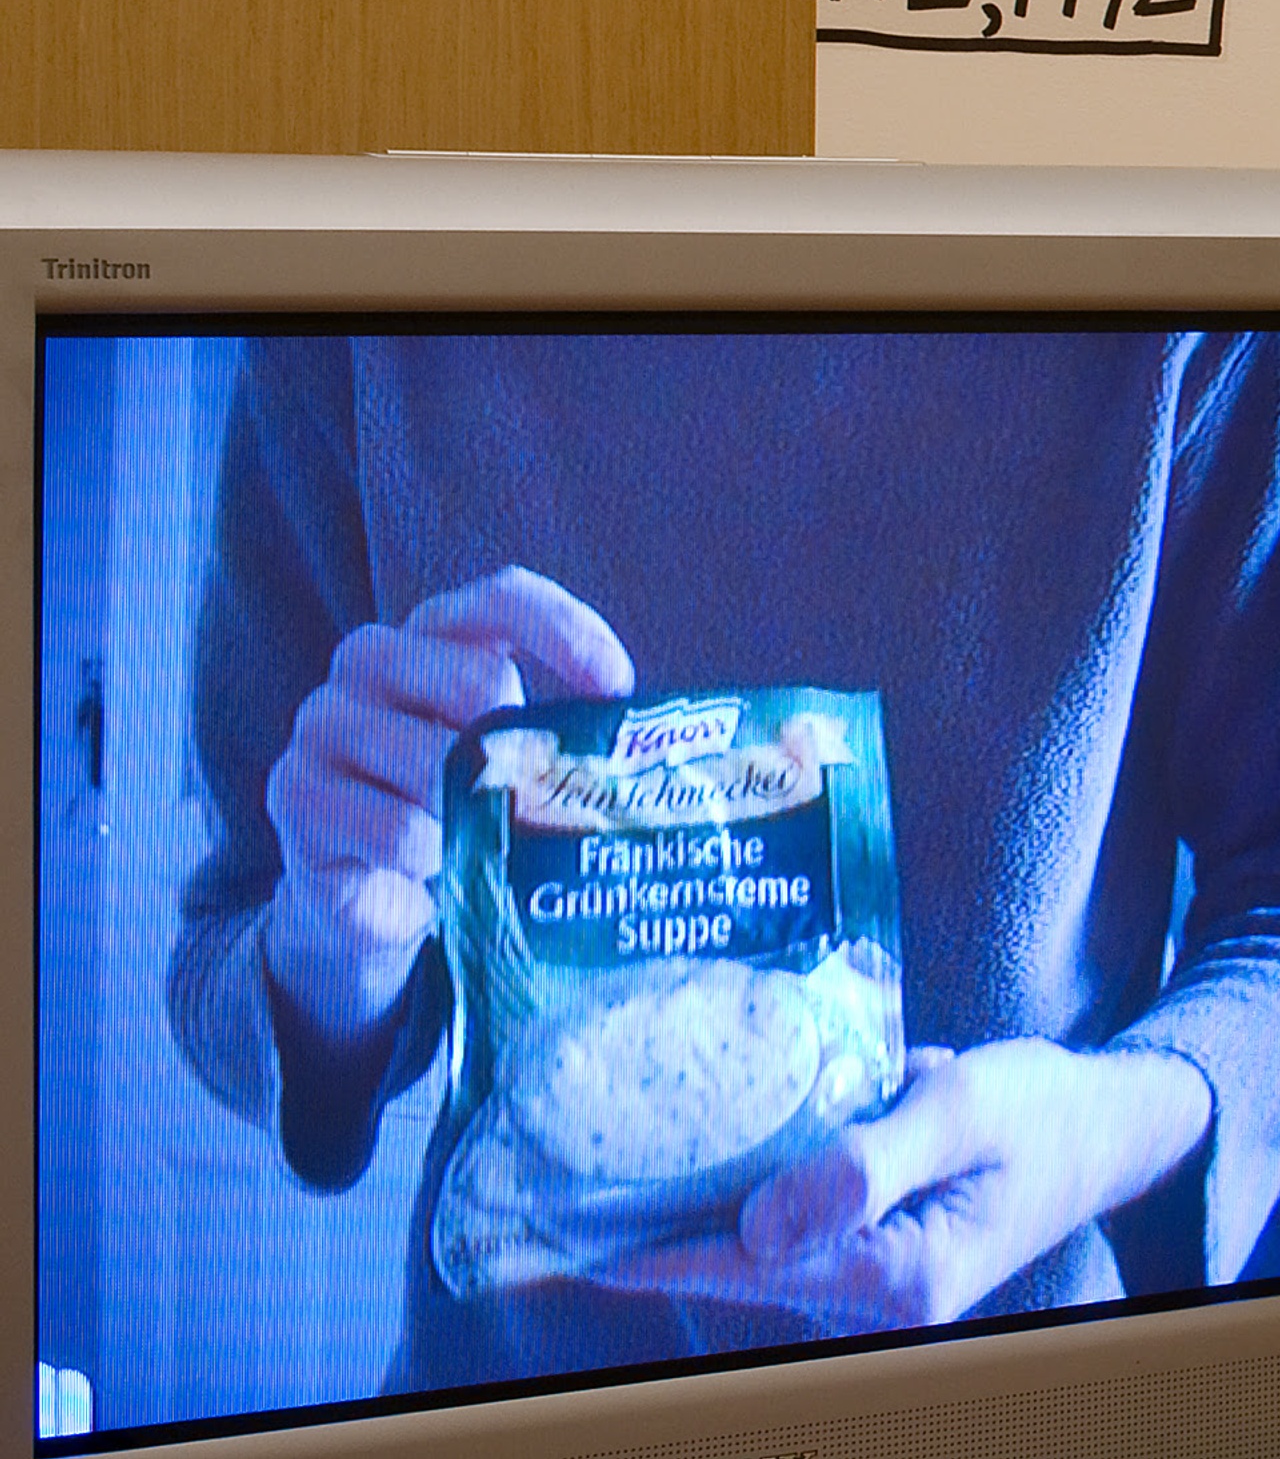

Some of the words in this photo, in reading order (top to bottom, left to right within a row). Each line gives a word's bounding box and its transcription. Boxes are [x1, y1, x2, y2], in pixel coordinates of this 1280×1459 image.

[41, 257, 151, 280] Trinitron
[624, 716, 731, 759] Knorr
[579, 827, 765, 877] Fränkische
[617, 912, 733, 956] Suppe
